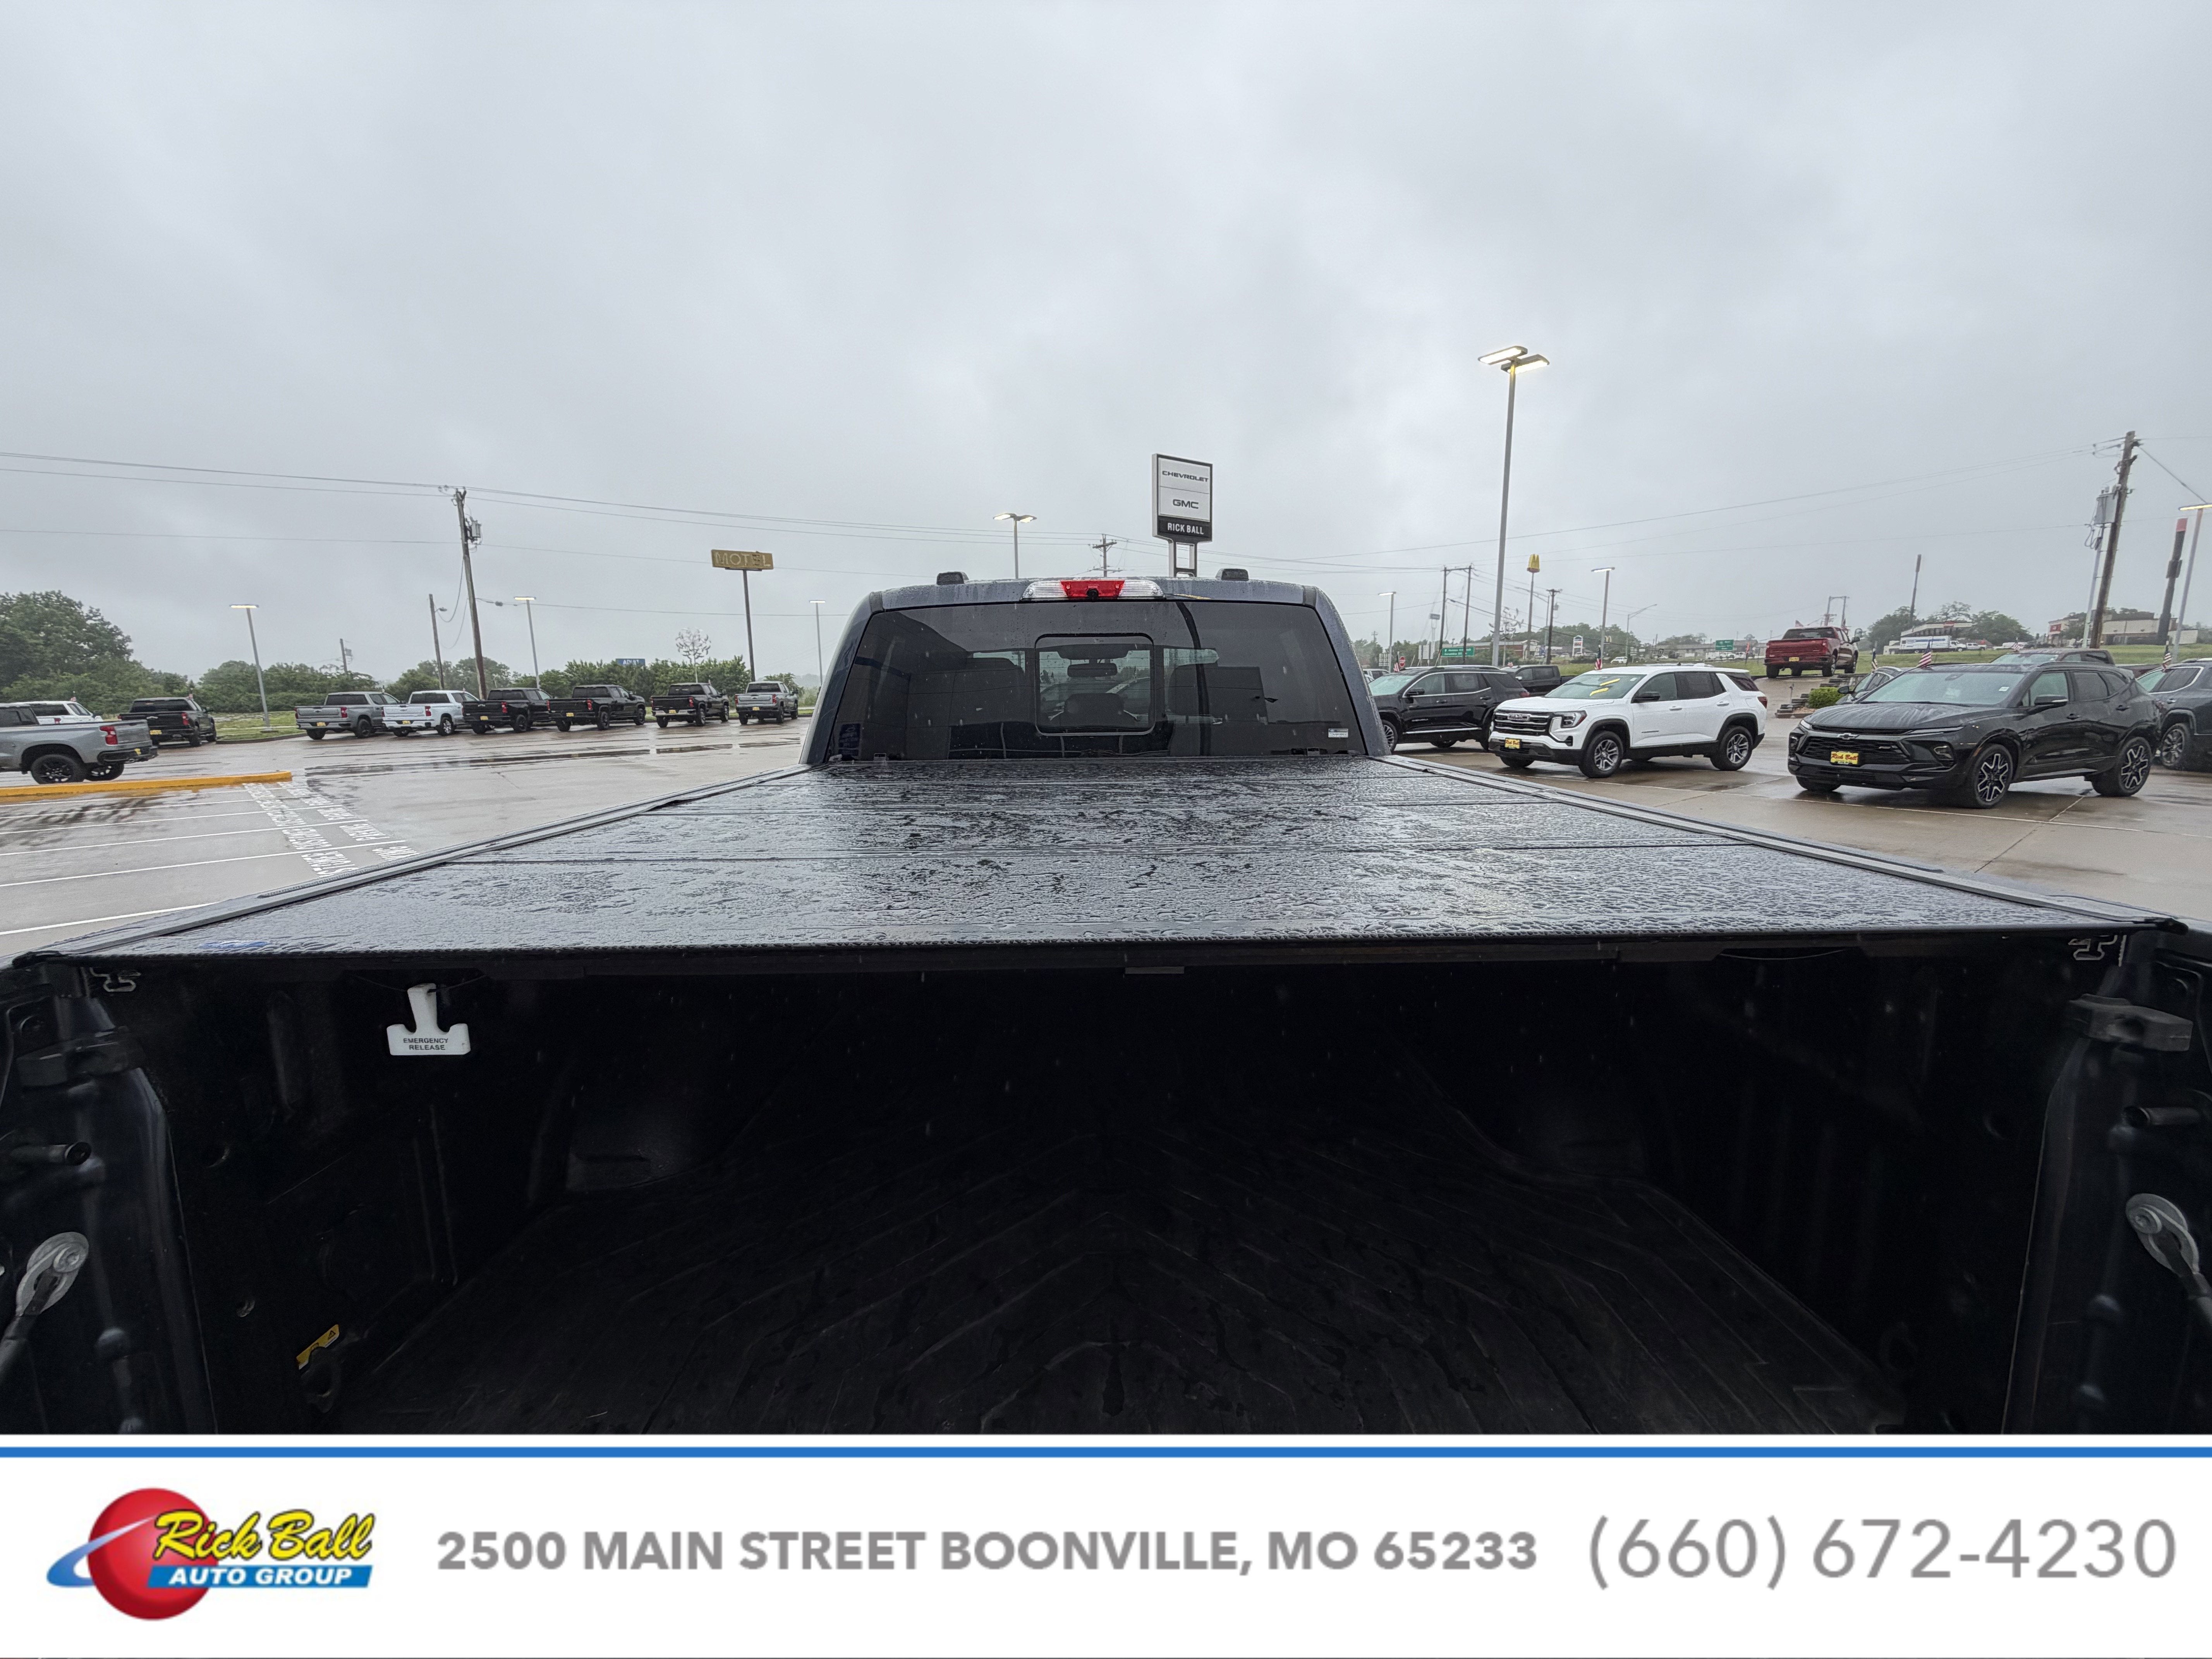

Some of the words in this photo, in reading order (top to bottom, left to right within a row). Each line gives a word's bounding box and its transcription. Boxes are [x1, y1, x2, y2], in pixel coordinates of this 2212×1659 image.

[1162, 471, 1208, 483] CHEVROLET
[1173, 499, 1199, 509] GMC
[1168, 522, 1184, 532] RICK
[1187, 525, 1204, 535] BALL
[301, 851, 359, 878] STOMER
